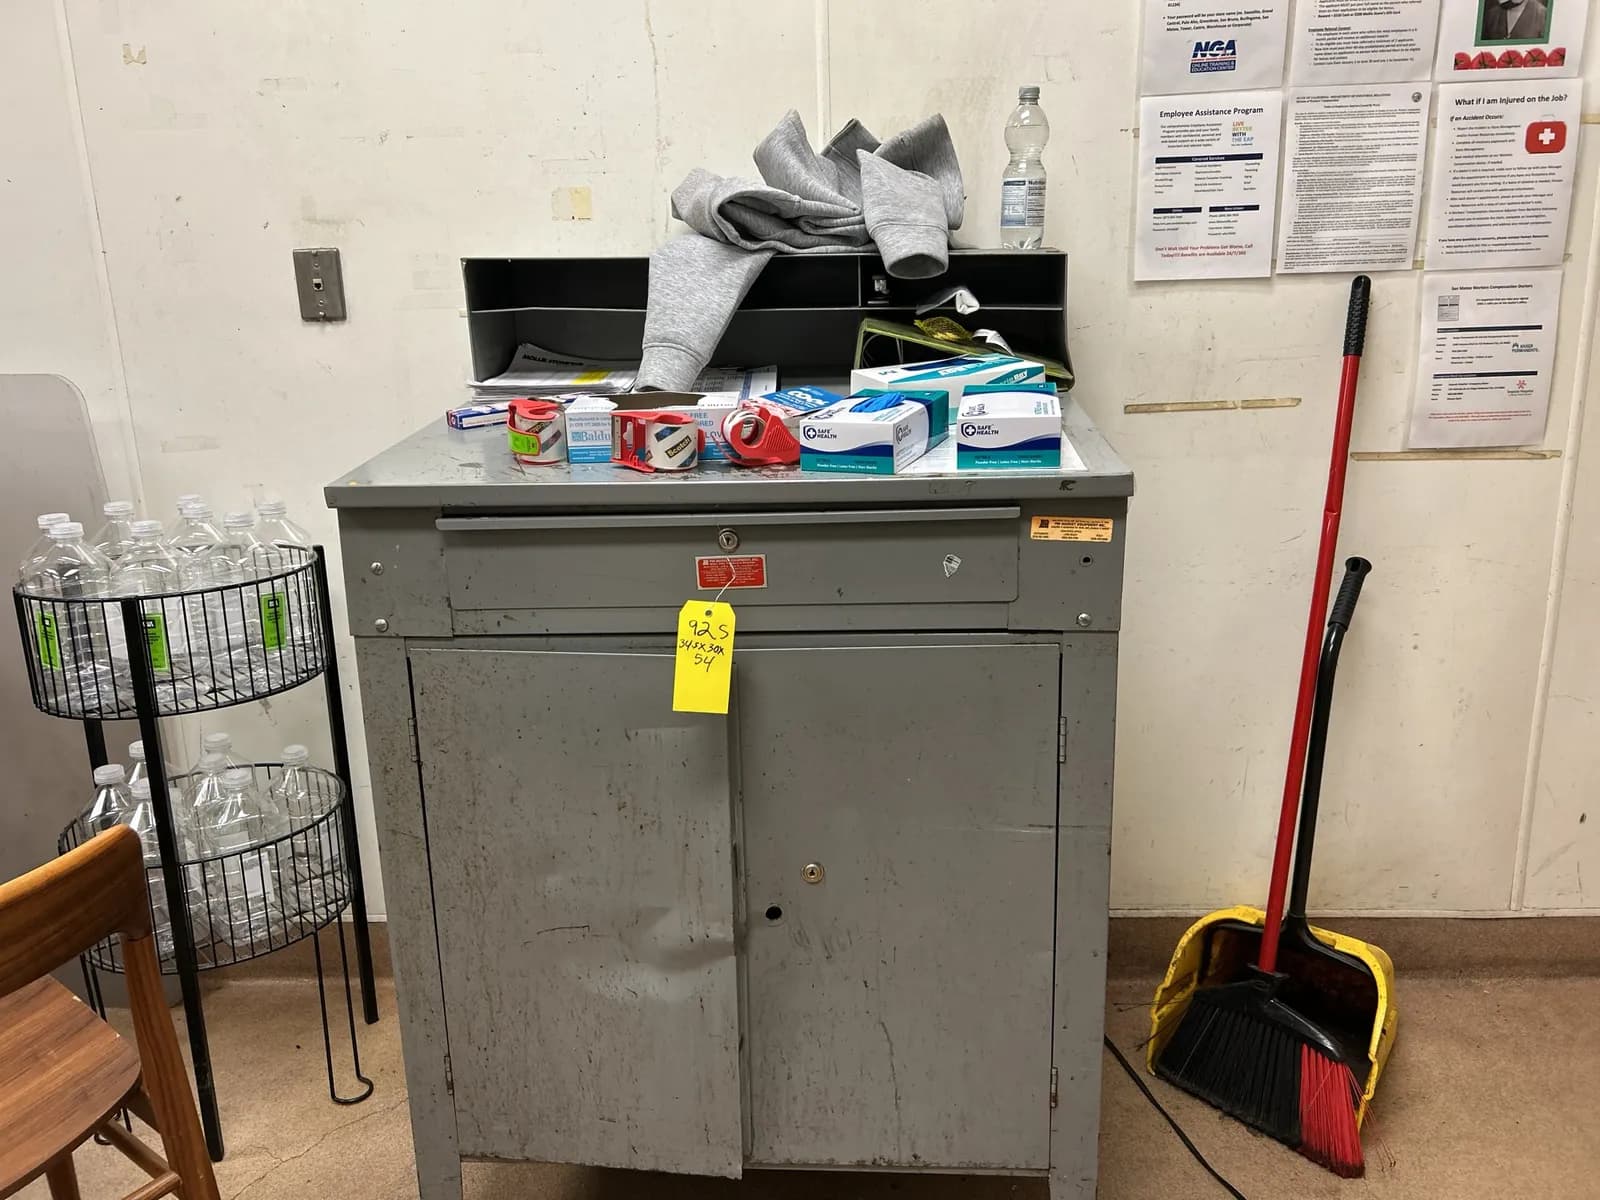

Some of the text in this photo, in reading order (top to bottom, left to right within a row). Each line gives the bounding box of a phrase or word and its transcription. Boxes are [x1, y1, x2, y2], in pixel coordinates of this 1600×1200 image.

[1192, 40, 1236, 58] NGA
[1500, 96, 1524, 104] Injured
[1160, 107, 1264, 119] Employee Assistance Program
[666, 436, 691, 456] Scotch
[695, 654, 715, 672] 54
